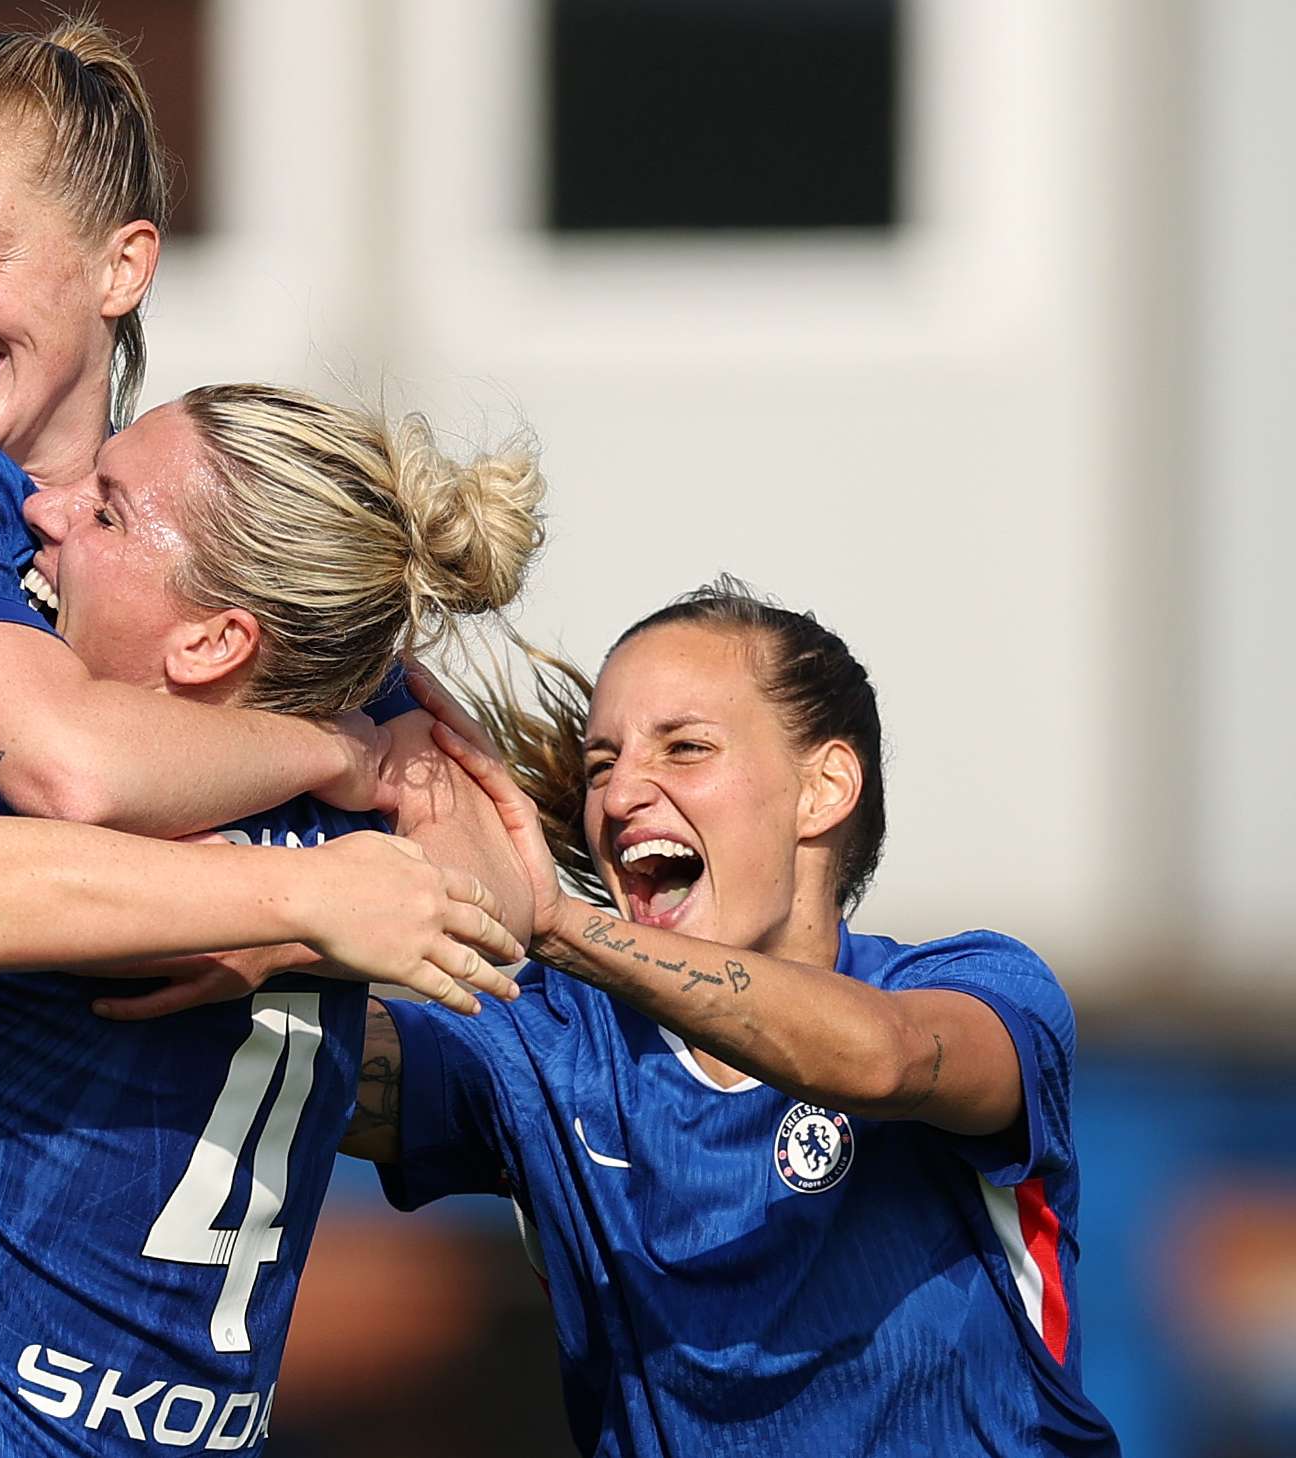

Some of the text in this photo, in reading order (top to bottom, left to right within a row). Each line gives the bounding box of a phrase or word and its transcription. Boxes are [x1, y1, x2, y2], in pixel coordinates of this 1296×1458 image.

[583, 916, 636, 953] Until
[681, 969, 724, 992] again
[782, 1104, 825, 1138] CHELSEA
[142, 992, 323, 1353] 4
